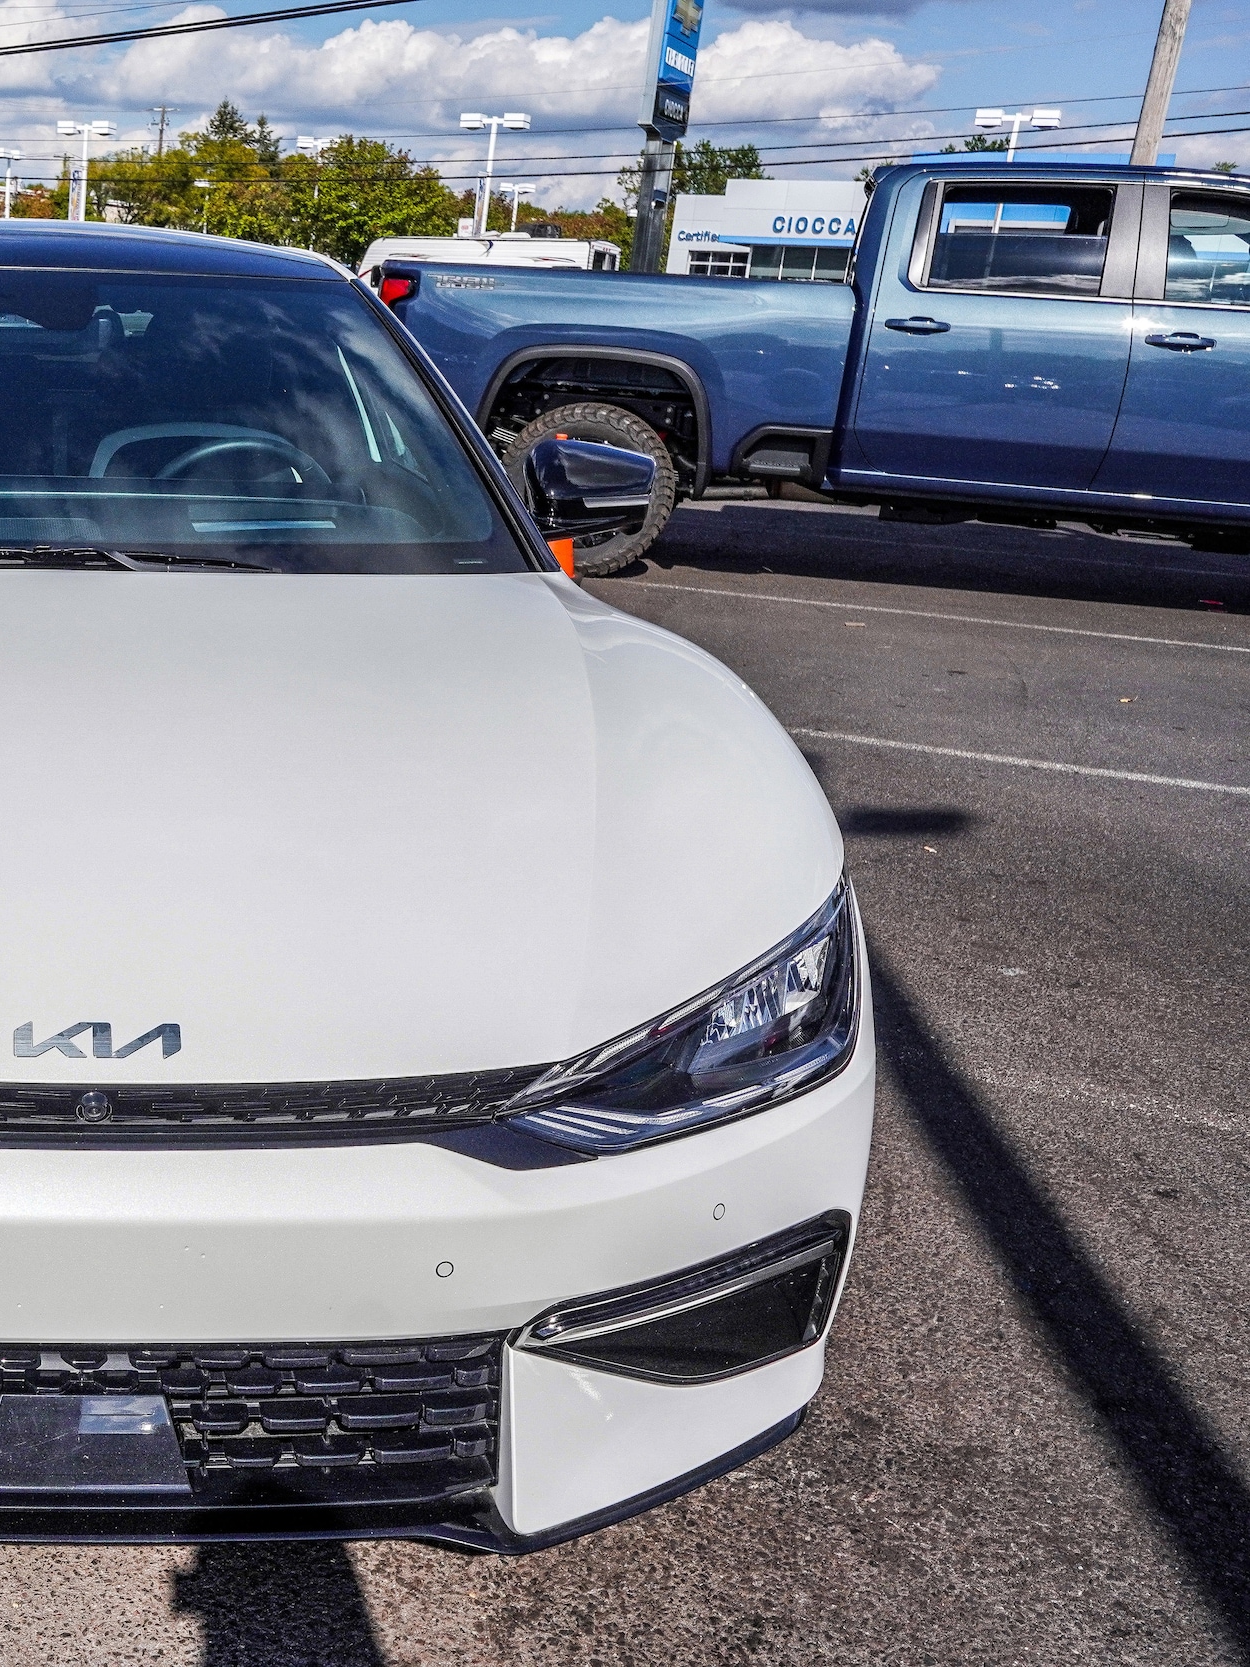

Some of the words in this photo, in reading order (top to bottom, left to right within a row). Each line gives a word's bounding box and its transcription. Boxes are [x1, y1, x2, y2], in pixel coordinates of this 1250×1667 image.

[772, 216, 856, 236] CIOCCA
[677, 230, 721, 243] Certifie
[13, 1021, 182, 1059] KIA
